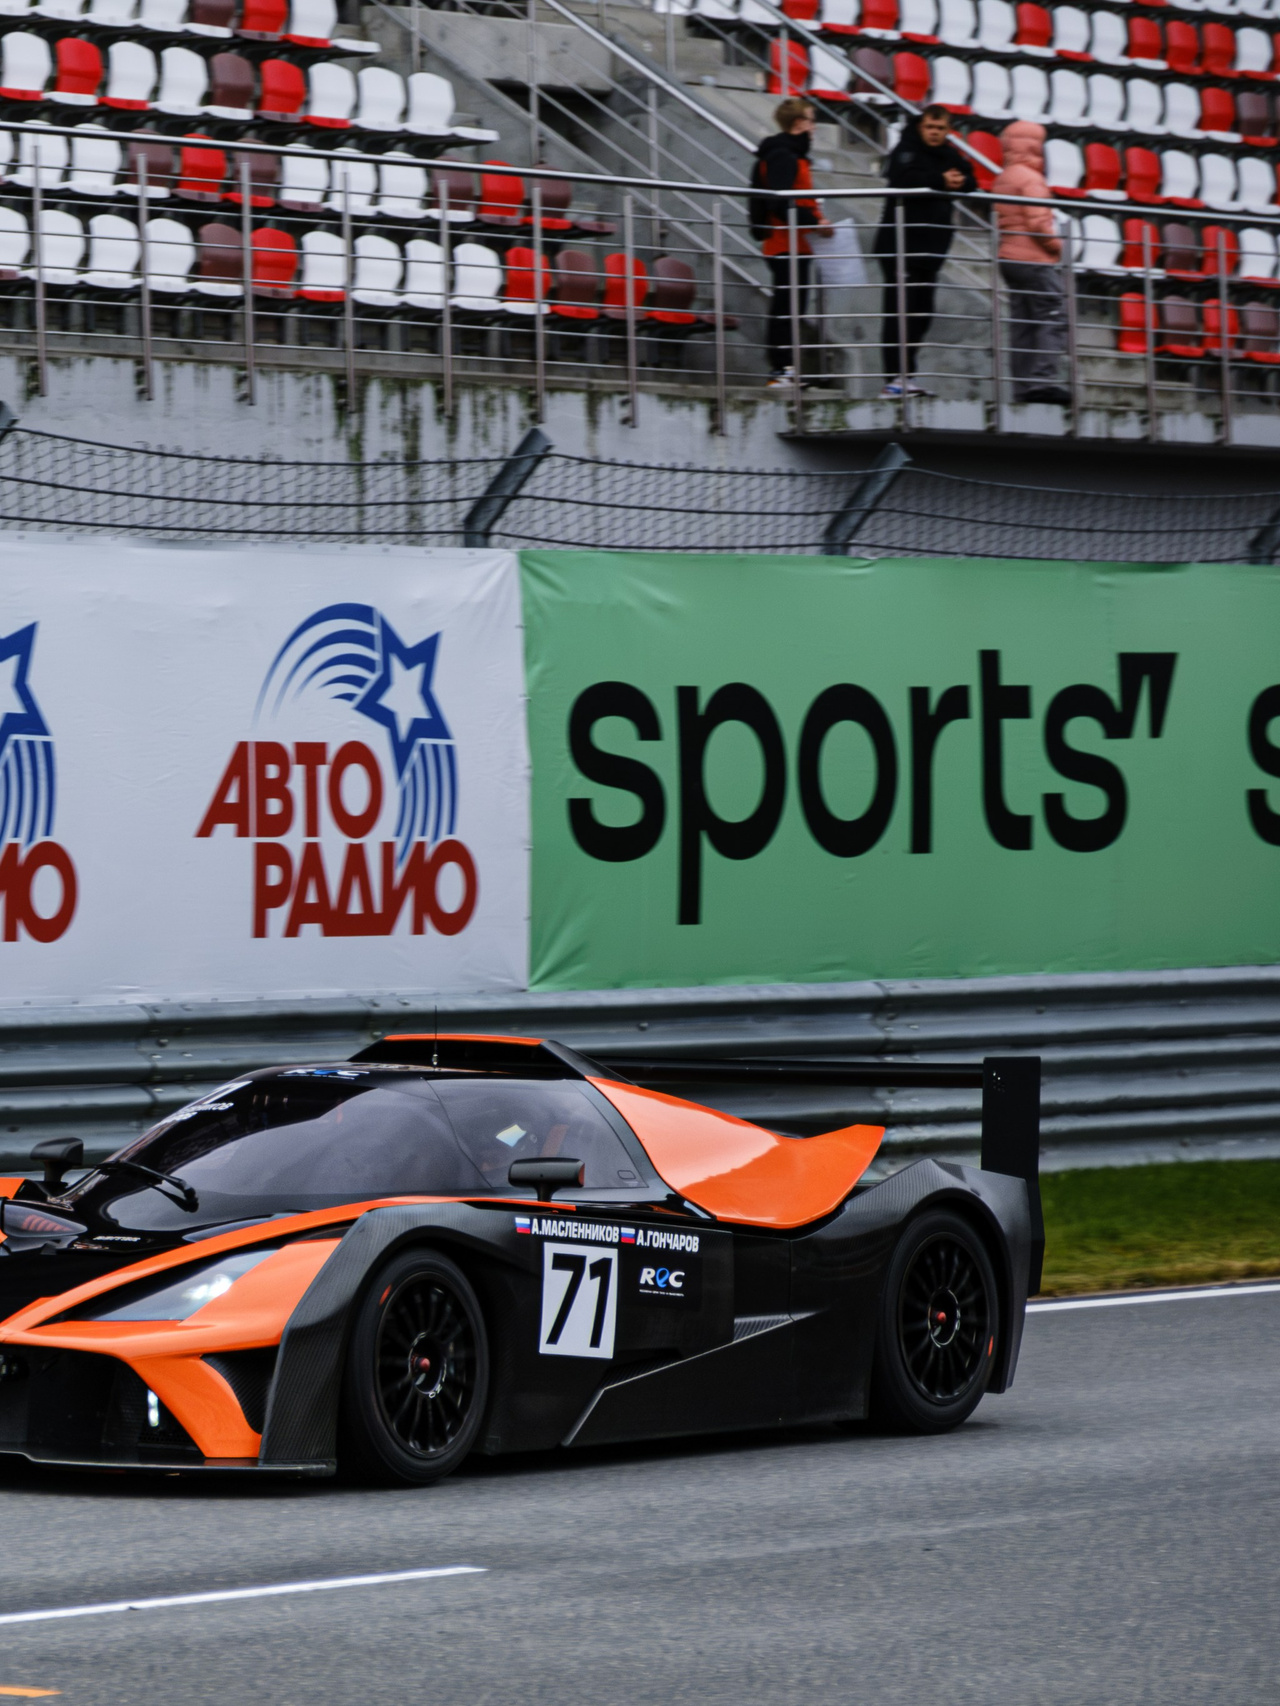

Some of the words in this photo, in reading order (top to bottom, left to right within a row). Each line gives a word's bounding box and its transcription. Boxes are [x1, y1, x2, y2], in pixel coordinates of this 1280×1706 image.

[196, 740, 383, 839] АВТО
[253, 839, 477, 939] РАДИО
[531, 1218, 619, 1243] А.МАСЛЕННИКОВ
[636, 1229, 700, 1253] А.ГОНЧАРОВ
[545, 1252, 613, 1349] 71
